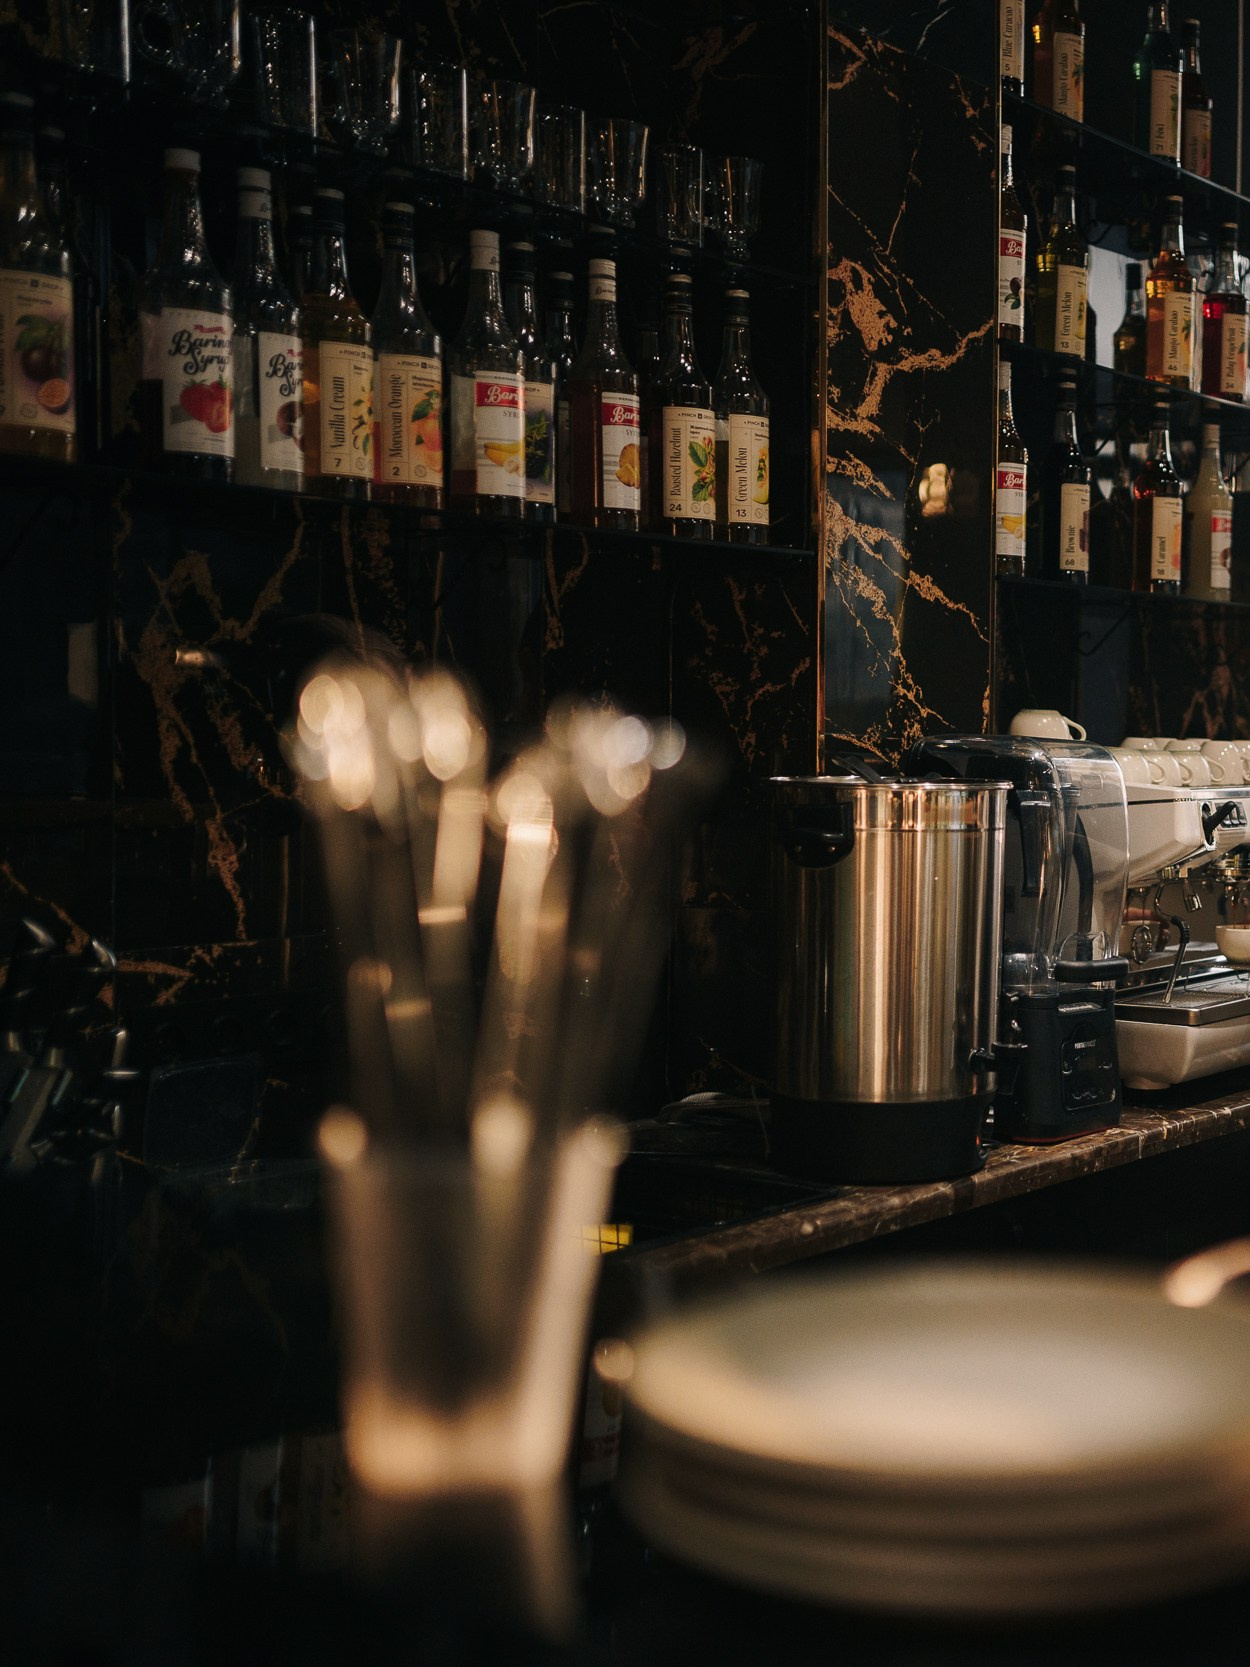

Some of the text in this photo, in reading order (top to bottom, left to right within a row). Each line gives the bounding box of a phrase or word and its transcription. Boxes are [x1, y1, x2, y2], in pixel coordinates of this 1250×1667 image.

[1003, 39, 1013, 58] Blue
[1060, 291, 1072, 336] Green Melon
[388, 374, 406, 409] Orange
[328, 376, 345, 449] Vanilla Cream
[669, 427, 682, 465] Hazelnut
[333, 457, 341, 467] 7
[392, 467, 400, 476] 2
[734, 447, 748, 502] Green Melon
[669, 503, 683, 512] 24
[735, 509, 747, 518] 13
[1065, 524, 1076, 553] Brownie
[1156, 535, 1166, 564] Caramel
